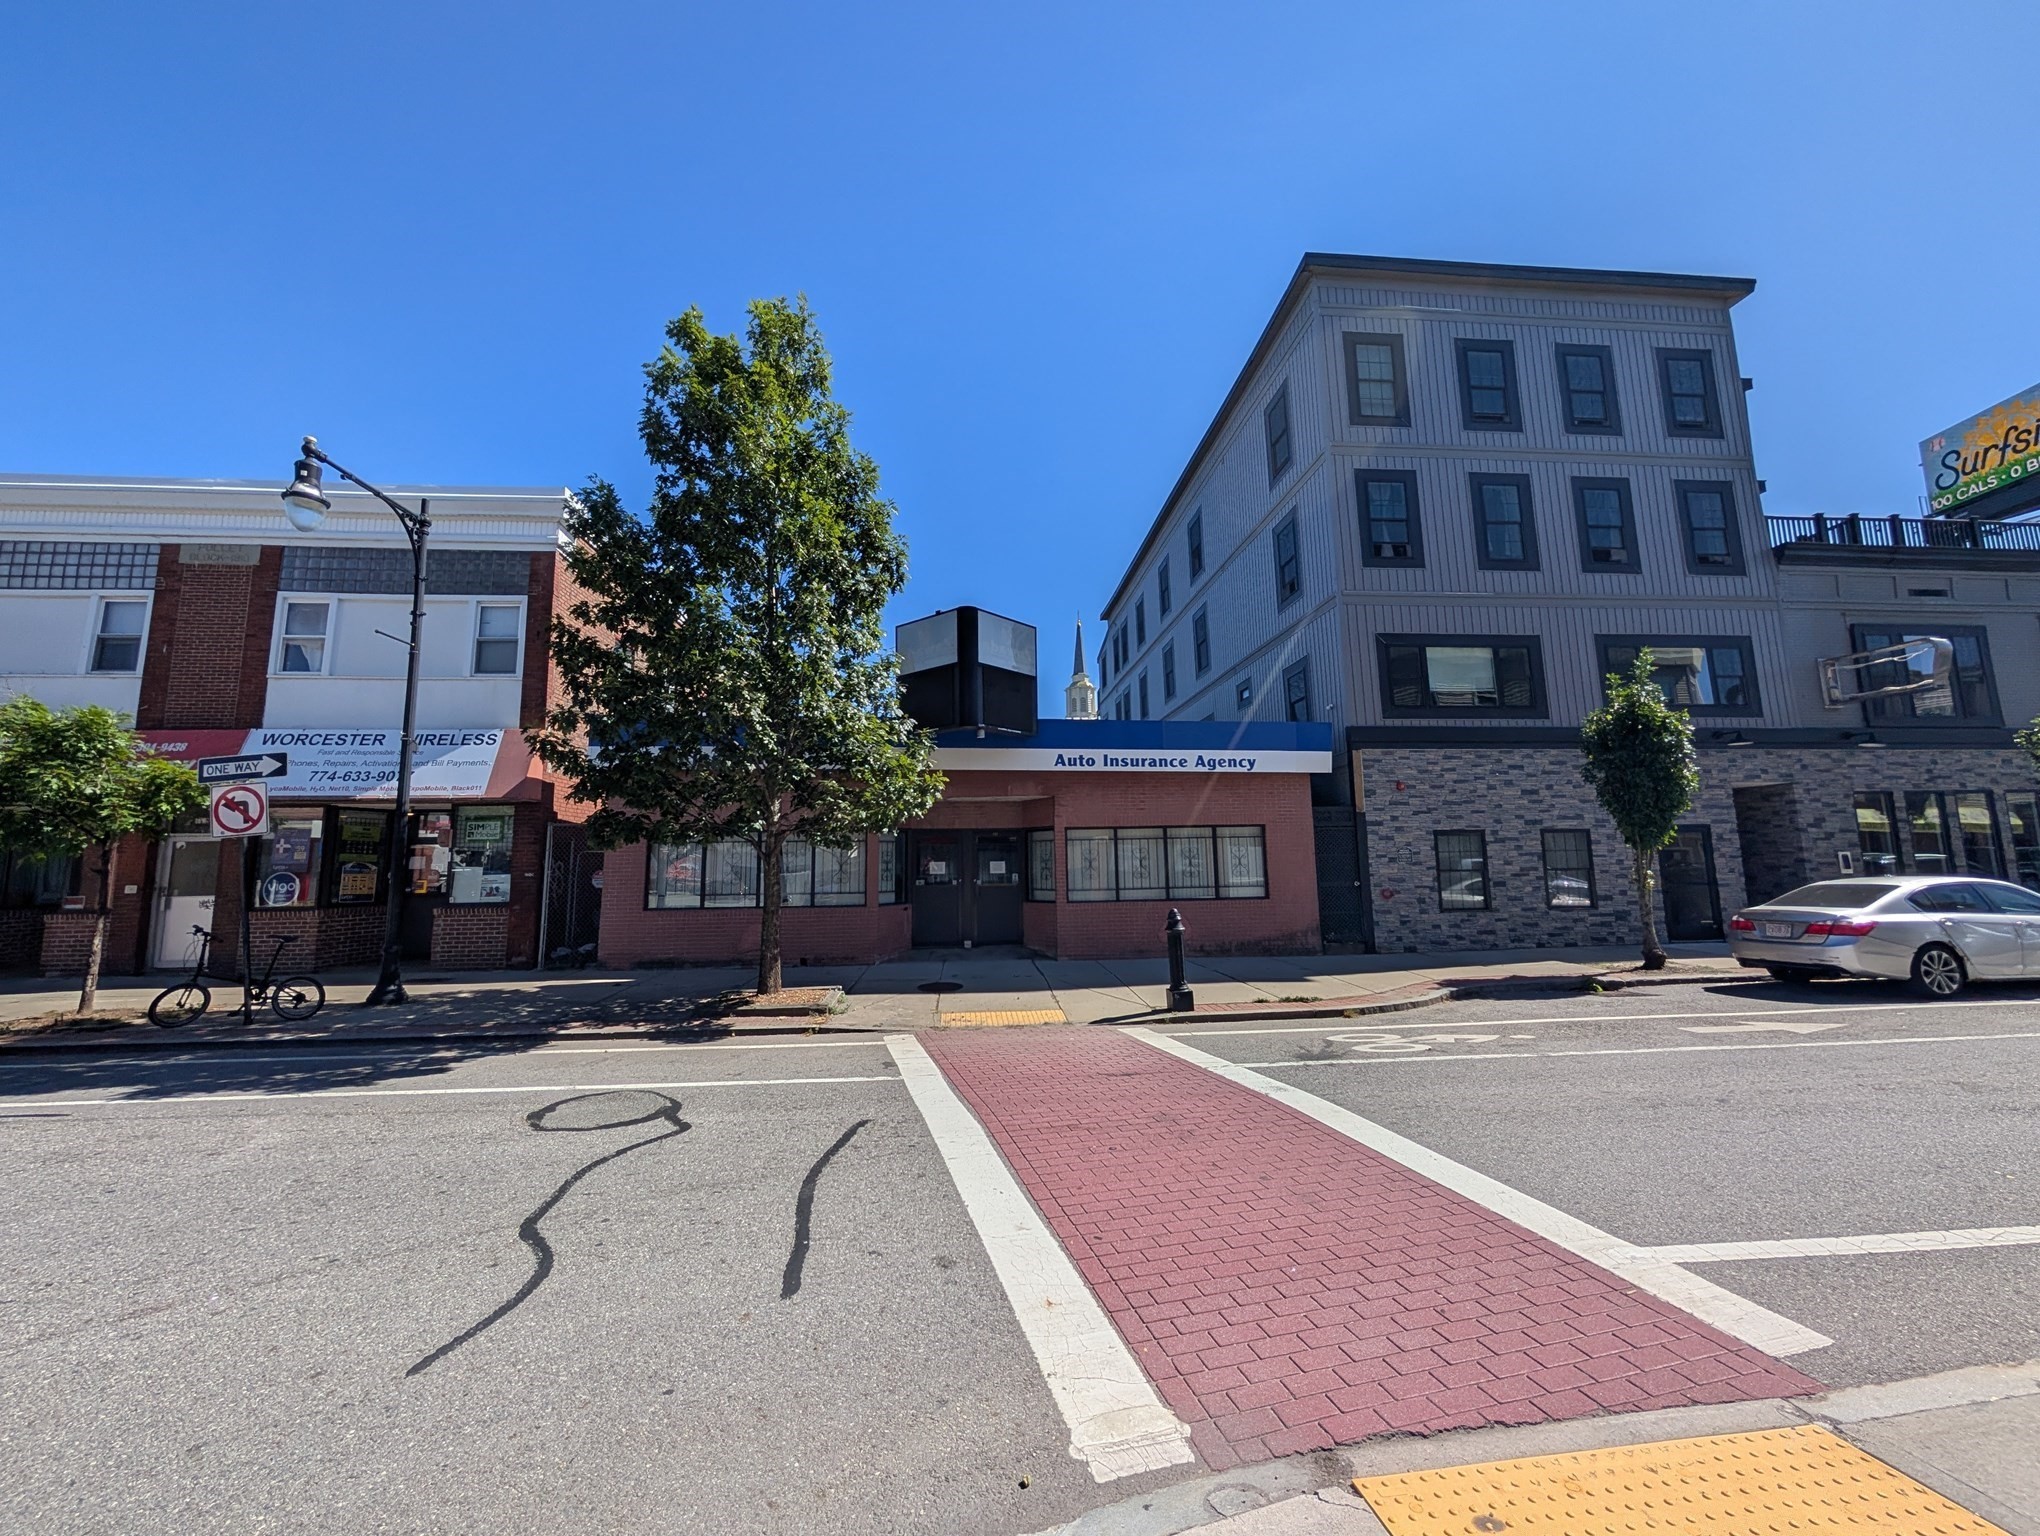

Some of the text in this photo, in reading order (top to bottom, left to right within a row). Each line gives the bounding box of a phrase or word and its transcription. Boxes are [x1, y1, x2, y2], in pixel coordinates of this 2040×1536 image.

[1931, 494, 1953, 511] 100
[1956, 475, 1998, 500] CALS
[262, 733, 386, 746] WORCESTER
[351, 749, 396, 758] Responsible
[206, 761, 261, 775] ONE WAY
[323, 760, 359, 769] Repairs,
[446, 760, 491, 768] Payments.
[1054, 754, 1257, 771] Auto Insurance Agency
[468, 823, 498, 831] SIMPLE
